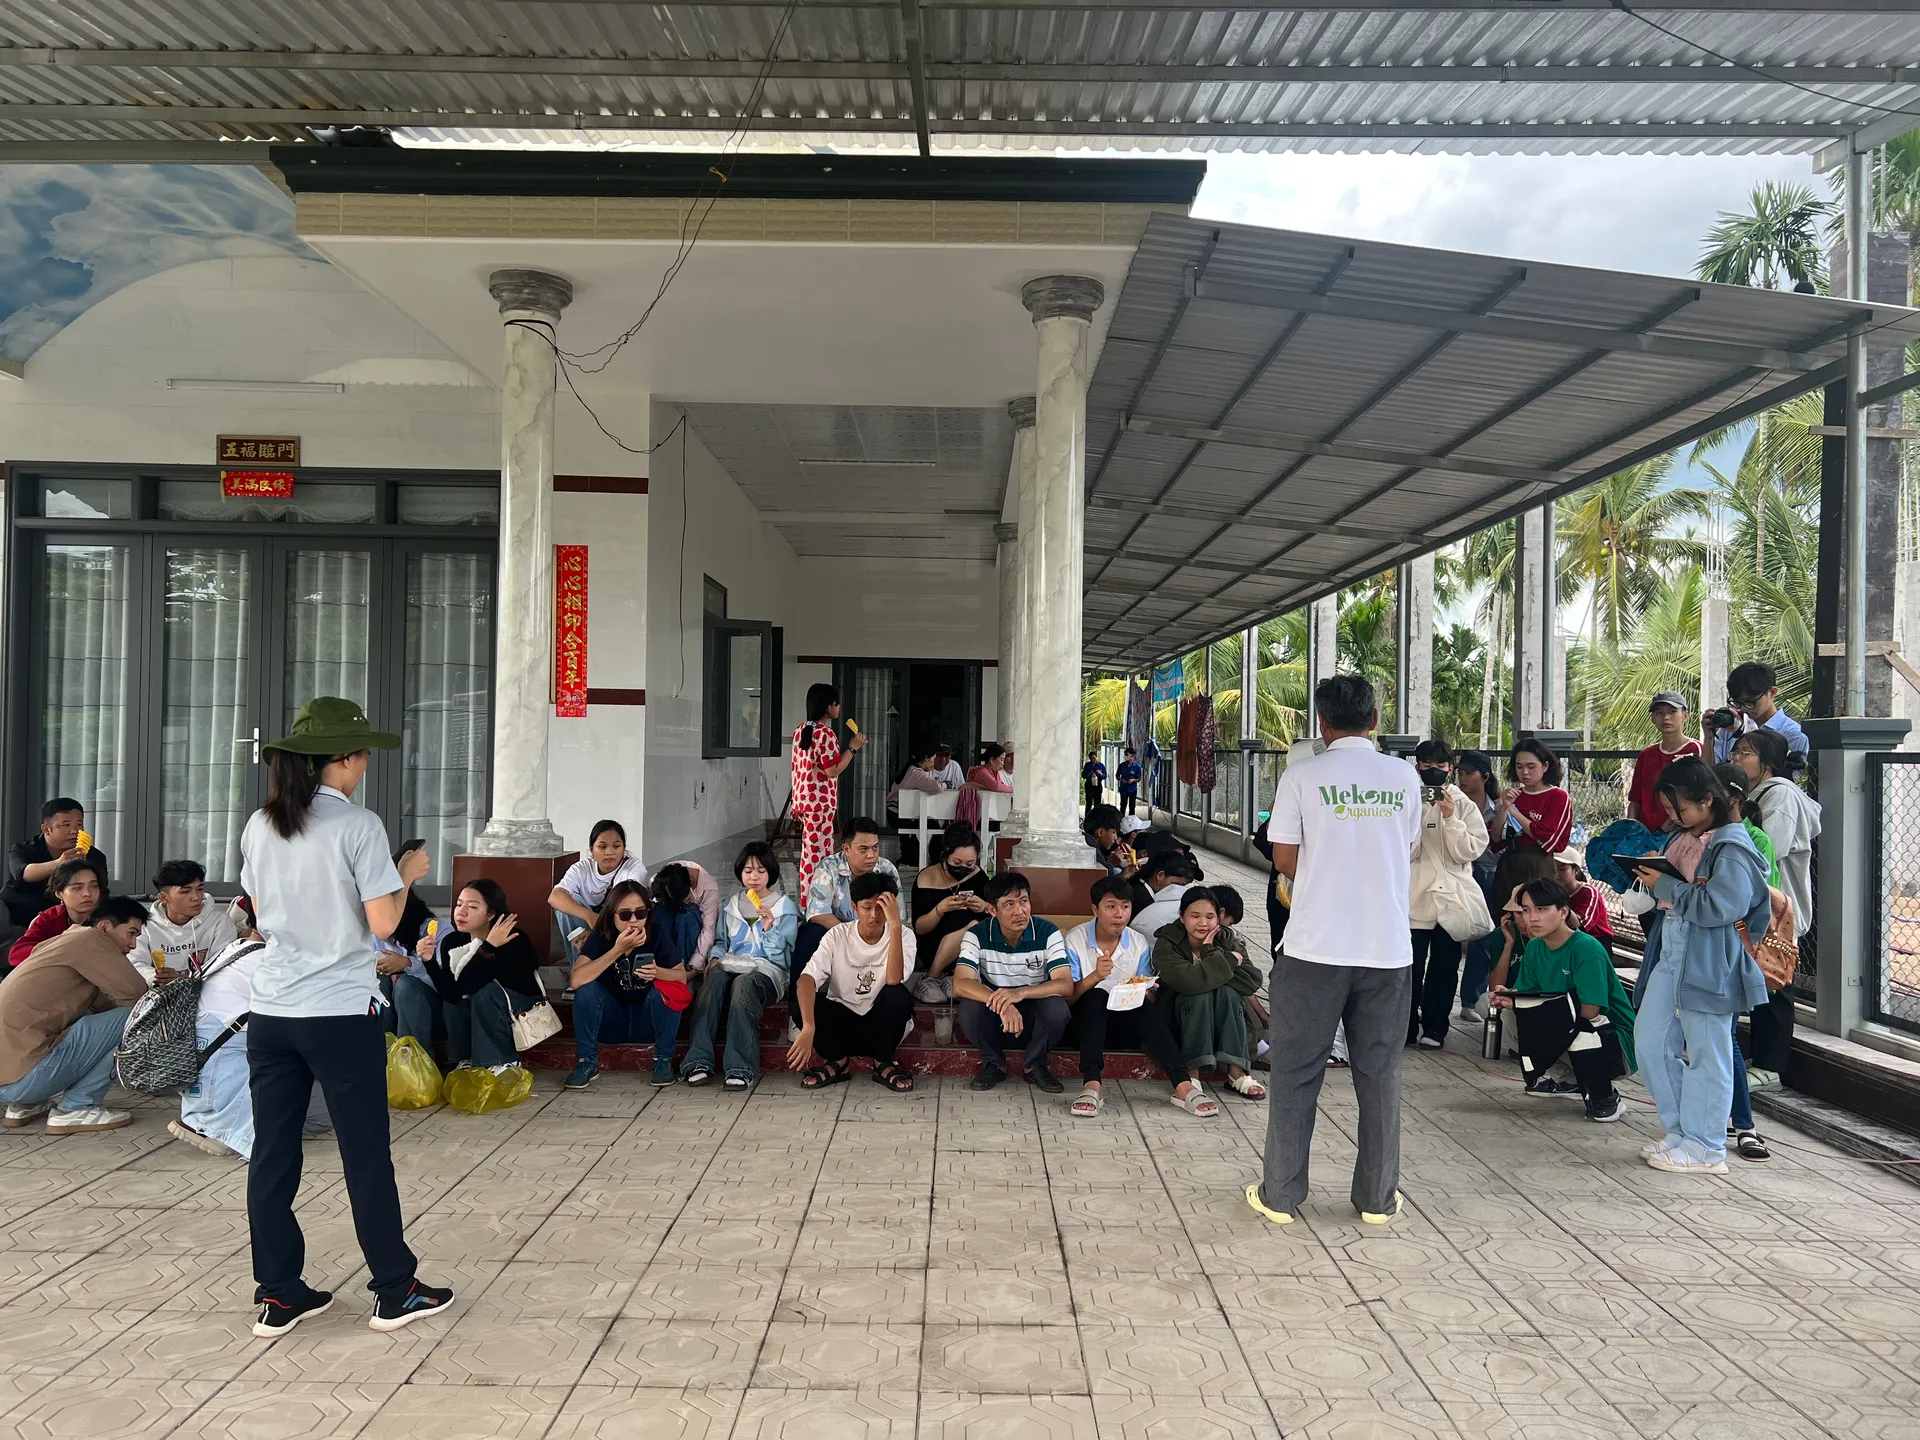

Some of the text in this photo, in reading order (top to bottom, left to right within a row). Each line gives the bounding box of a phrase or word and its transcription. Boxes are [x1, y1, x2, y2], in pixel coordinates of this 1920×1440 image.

[222, 442, 295, 459] 五福臨門
[563, 556, 583, 689] 心心相印合百年
[1318, 784, 1404, 812] Mekong
[1334, 804, 1393, 822] Organics
